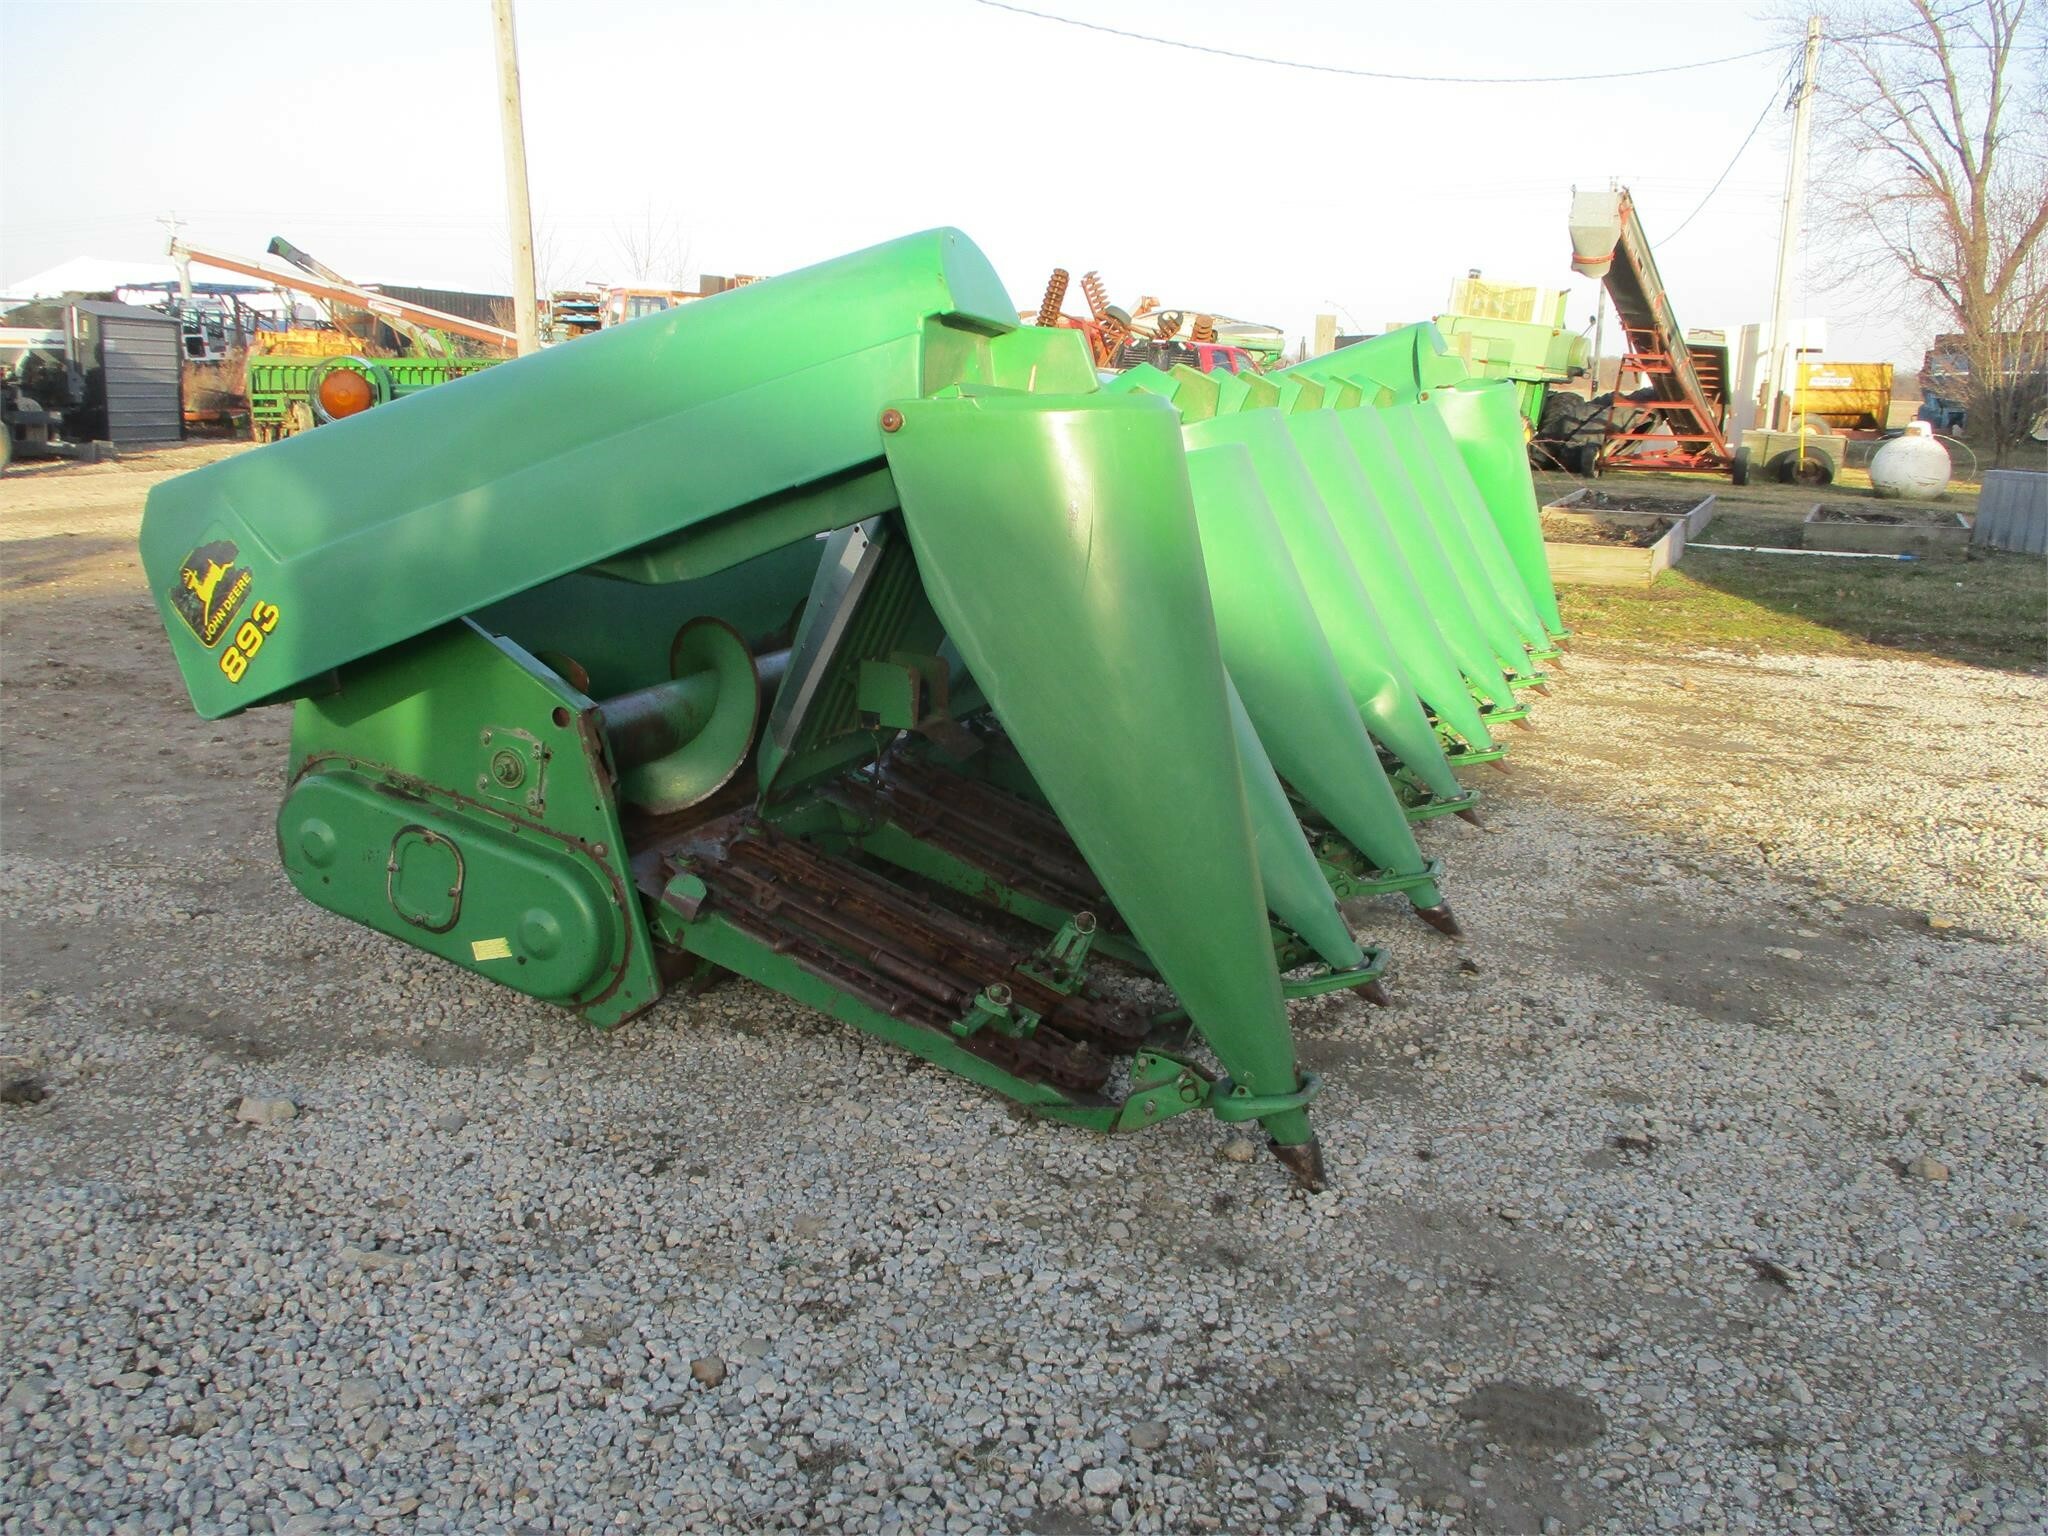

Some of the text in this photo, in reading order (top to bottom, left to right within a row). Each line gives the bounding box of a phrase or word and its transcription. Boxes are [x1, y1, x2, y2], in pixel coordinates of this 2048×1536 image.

[204, 571, 252, 641] JOHN DEERE
[219, 600, 280, 683] 893
